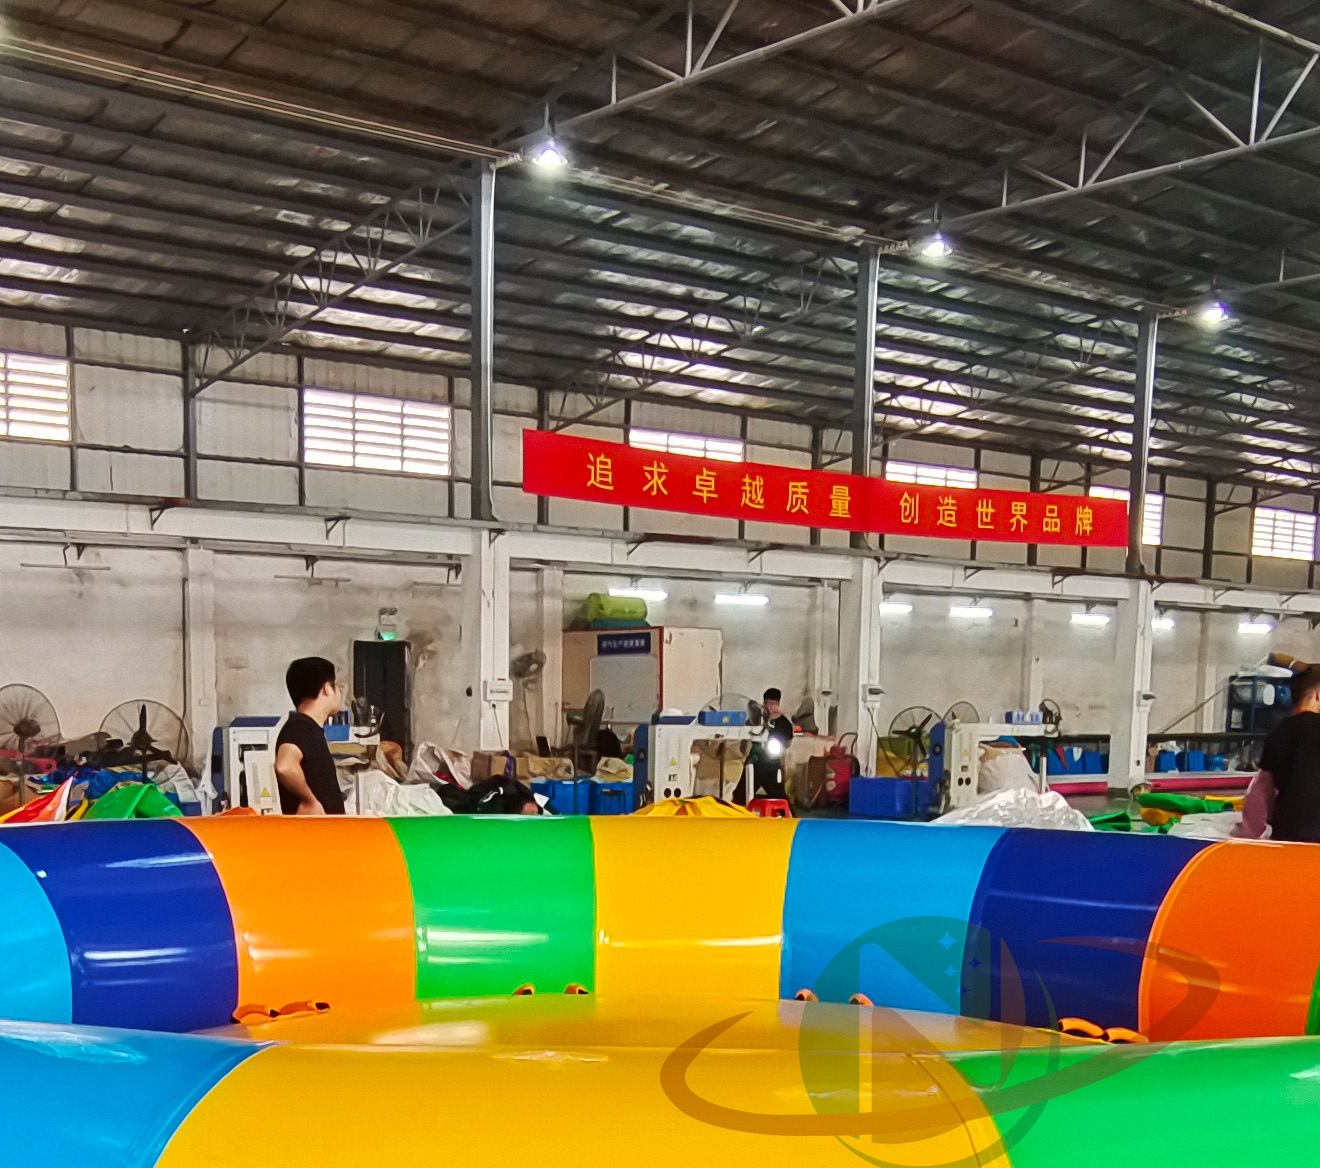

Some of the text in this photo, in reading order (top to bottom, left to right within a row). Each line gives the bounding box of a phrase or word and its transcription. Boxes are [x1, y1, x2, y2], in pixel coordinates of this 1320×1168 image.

[586, 453, 1094, 537] 追求卓越质量 创造世界品牌
